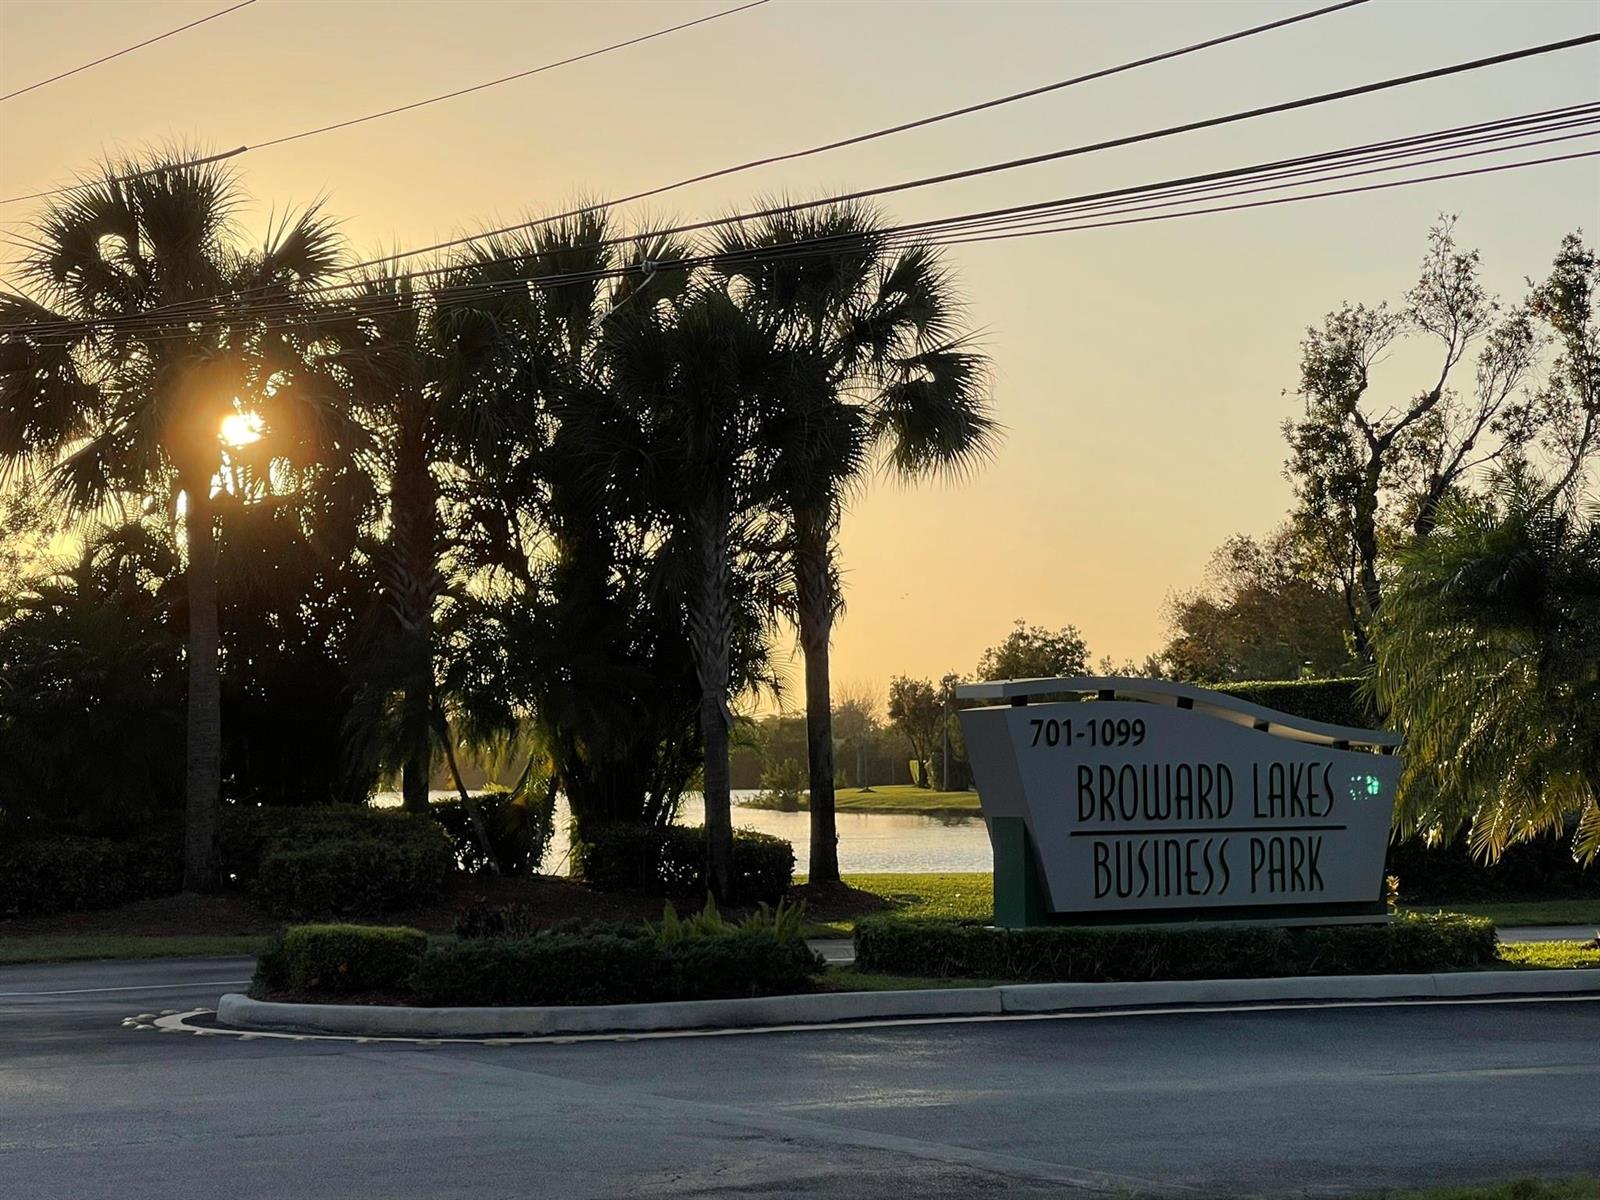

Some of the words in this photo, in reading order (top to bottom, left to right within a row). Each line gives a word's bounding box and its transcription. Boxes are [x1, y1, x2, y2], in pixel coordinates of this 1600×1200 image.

[1030, 718, 1147, 747] 701-1099
[1077, 762, 1234, 822] BROWARD
[1253, 761, 1335, 818] LAKES
[1094, 837, 1232, 899] BUSINESS
[1250, 835, 1326, 893] PARK
